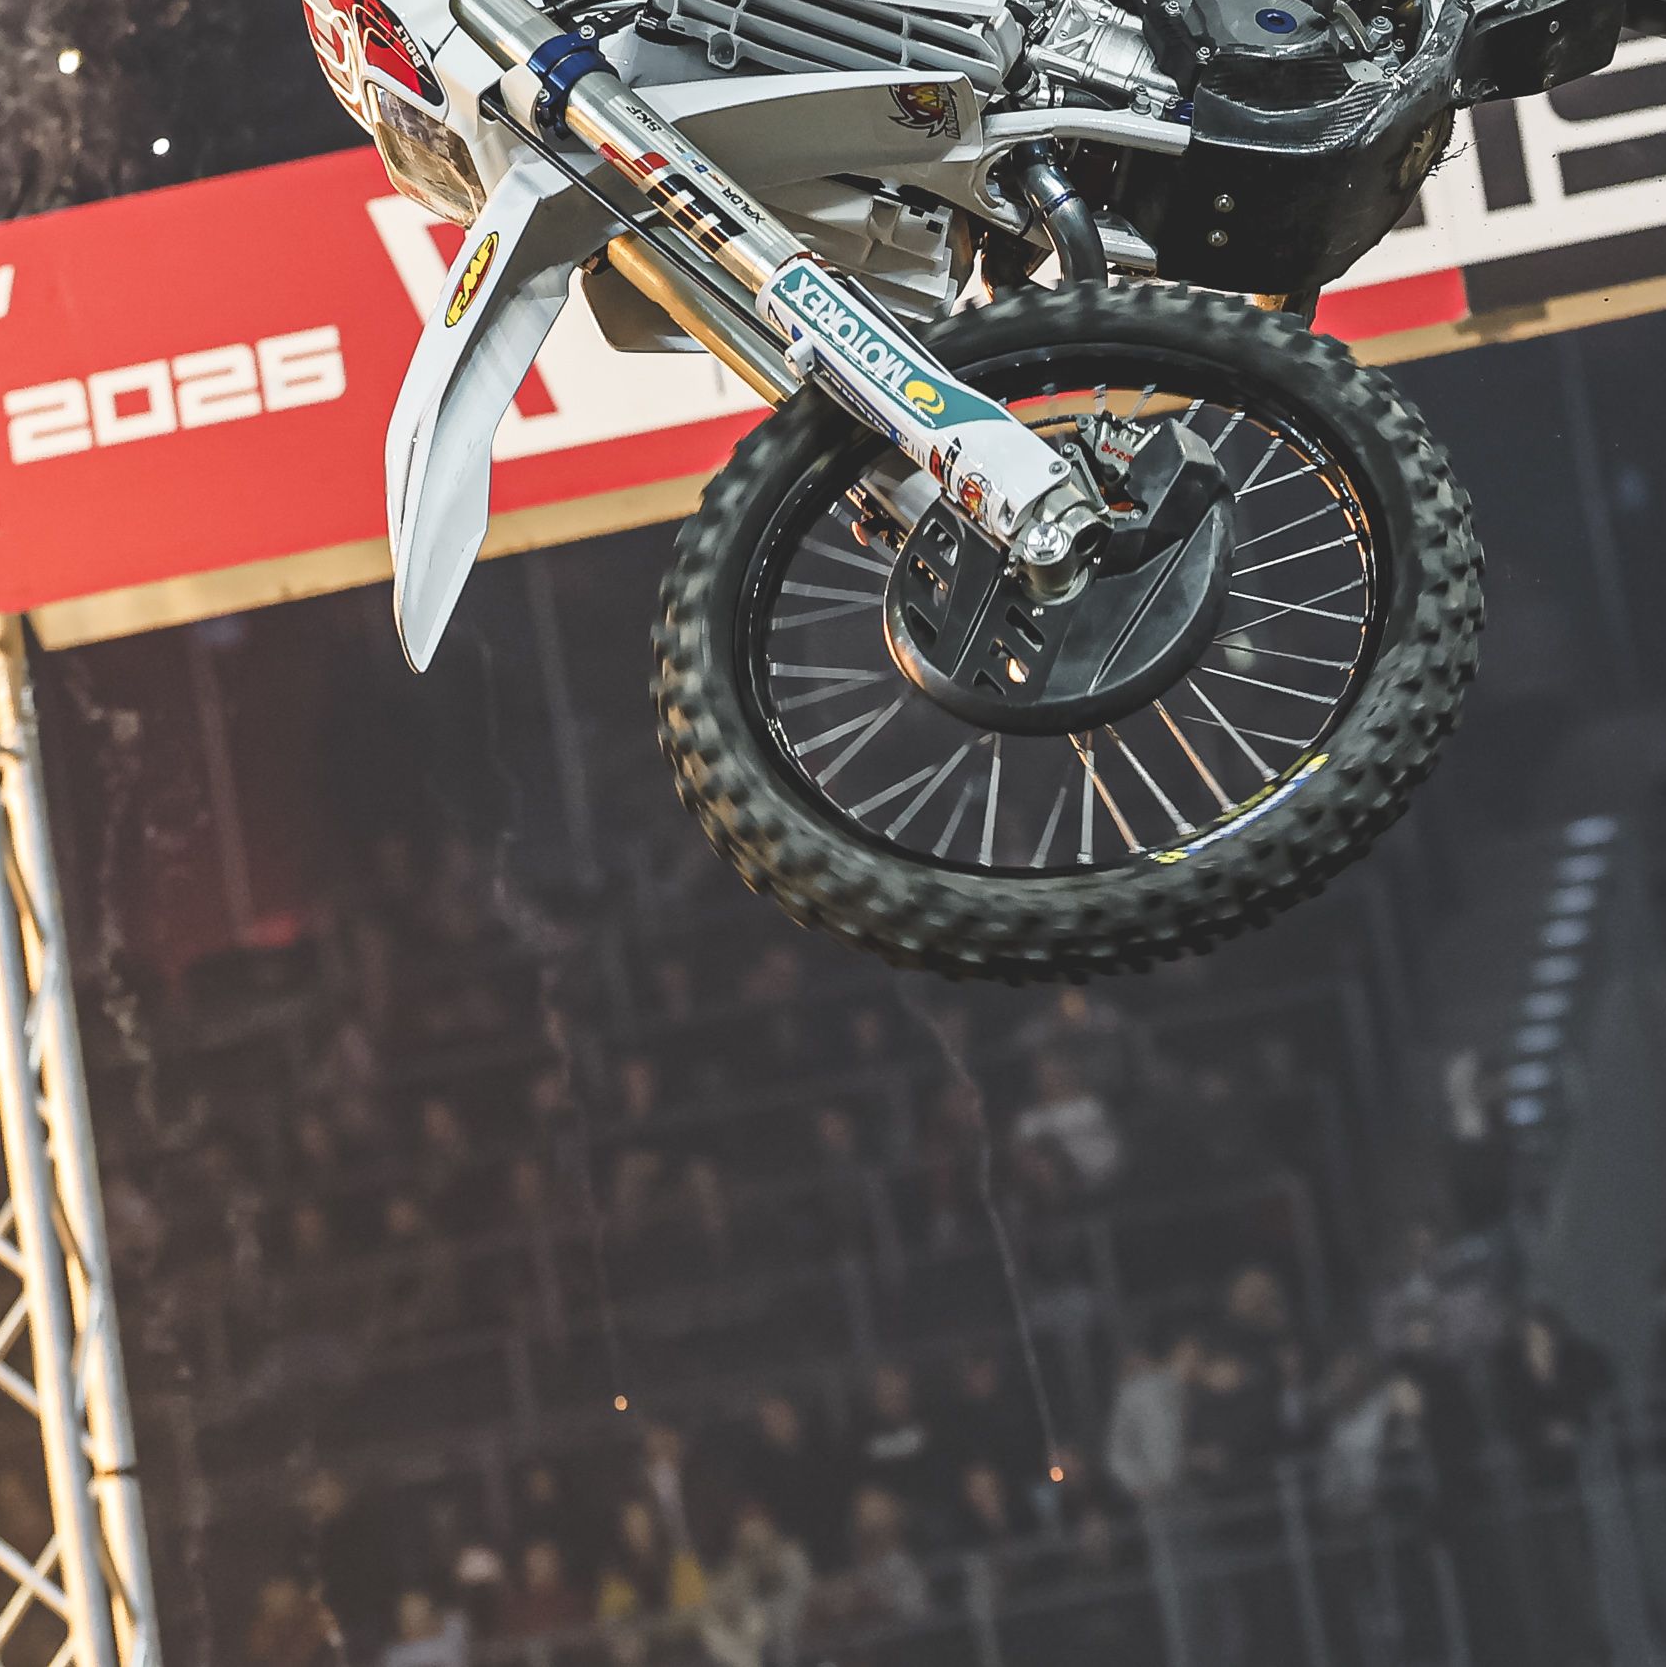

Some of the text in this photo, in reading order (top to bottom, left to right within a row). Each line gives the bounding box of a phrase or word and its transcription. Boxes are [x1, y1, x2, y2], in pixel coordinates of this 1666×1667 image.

[392, 22, 425, 69] BOLT
[625, 104, 664, 134] SKF
[447, 233, 498, 327] FMF
[795, 264, 914, 393] MOTOREX
[2, 325, 347, 466] 2026
